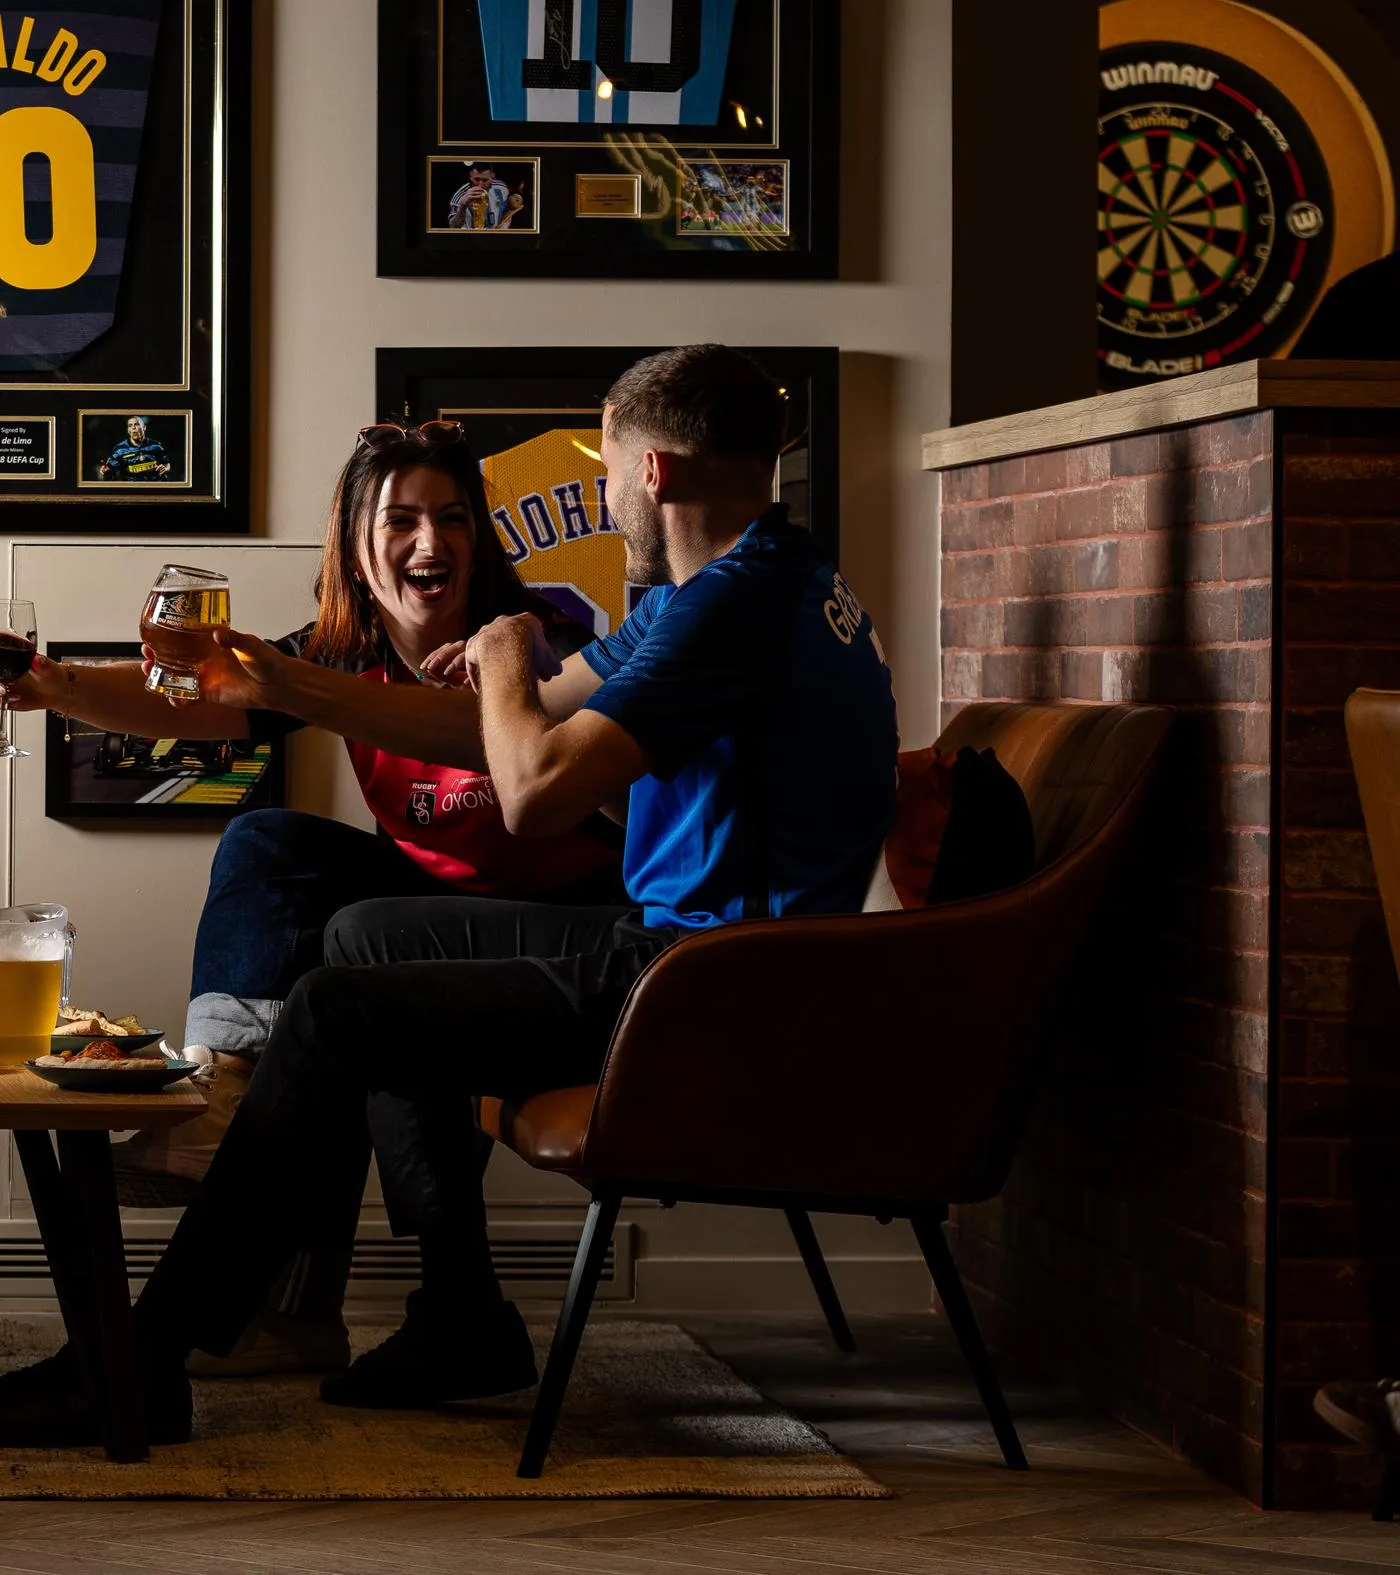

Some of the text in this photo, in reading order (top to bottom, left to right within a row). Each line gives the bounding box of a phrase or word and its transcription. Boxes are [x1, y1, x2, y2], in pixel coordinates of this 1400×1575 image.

[1100, 61, 1219, 92] WINMAU
[1, 427, 18, 435] Signed
[19, 427, 27, 435] By
[1, 436, 11, 445] de
[12, 436, 32, 445] Lima
[6, 455, 28, 464] UEFA
[28, 456, 45, 465] Cup
[442, 790, 493, 811] OYON
